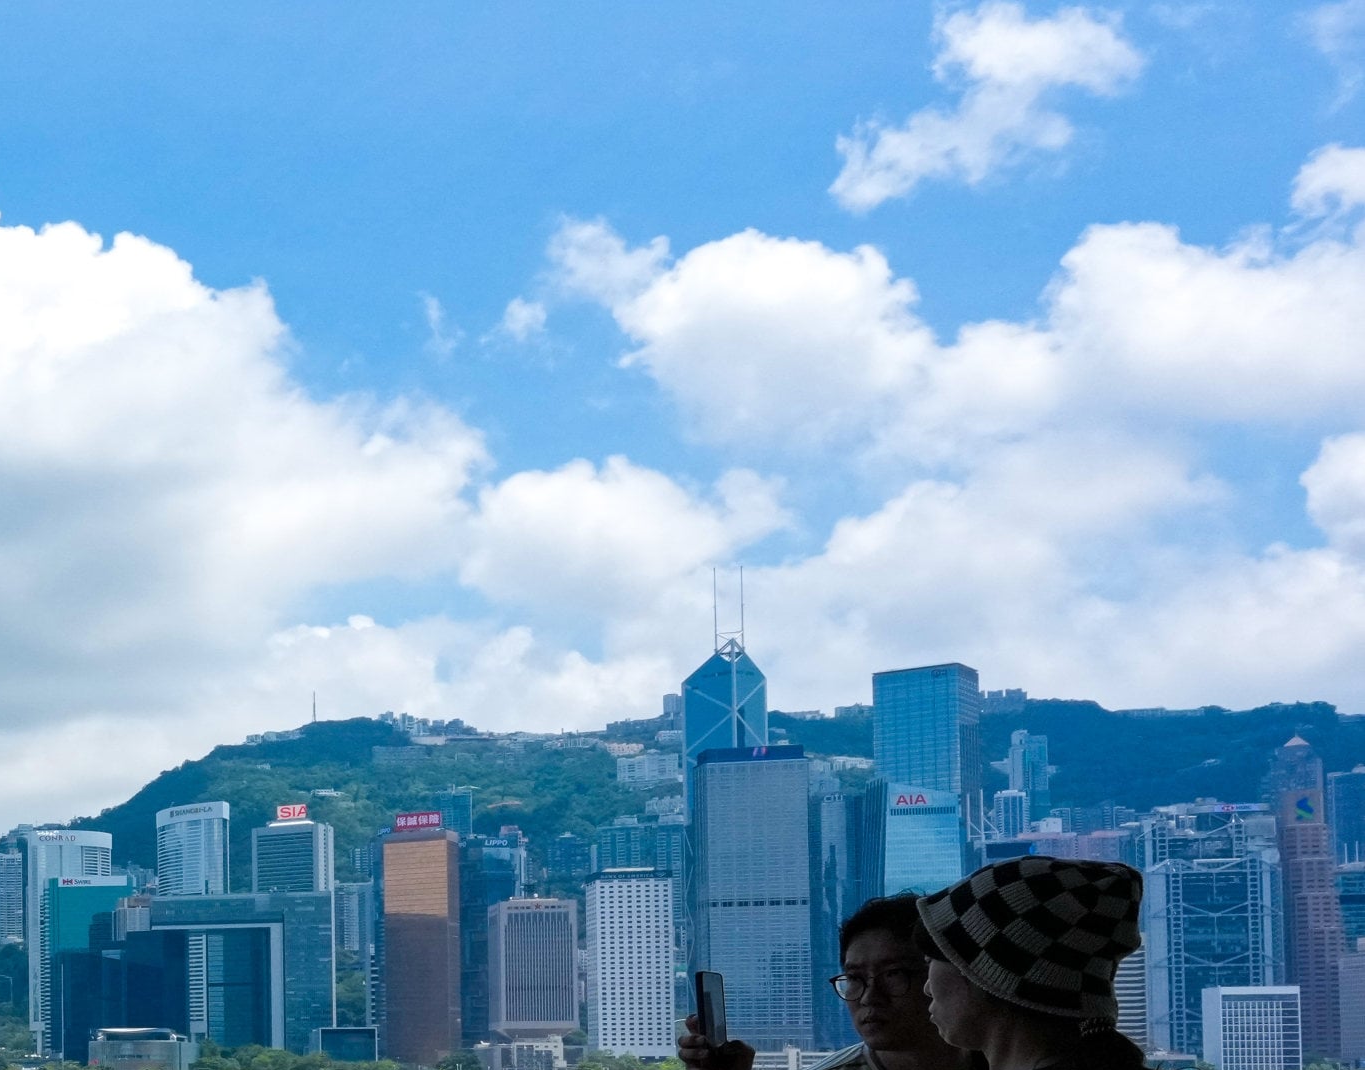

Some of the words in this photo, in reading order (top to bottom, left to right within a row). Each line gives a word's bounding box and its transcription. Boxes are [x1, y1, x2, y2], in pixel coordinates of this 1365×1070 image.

[896, 794, 927, 806] AIA
[38, 834, 77, 842] CONRAD
[484, 839, 508, 847] LIPPO
